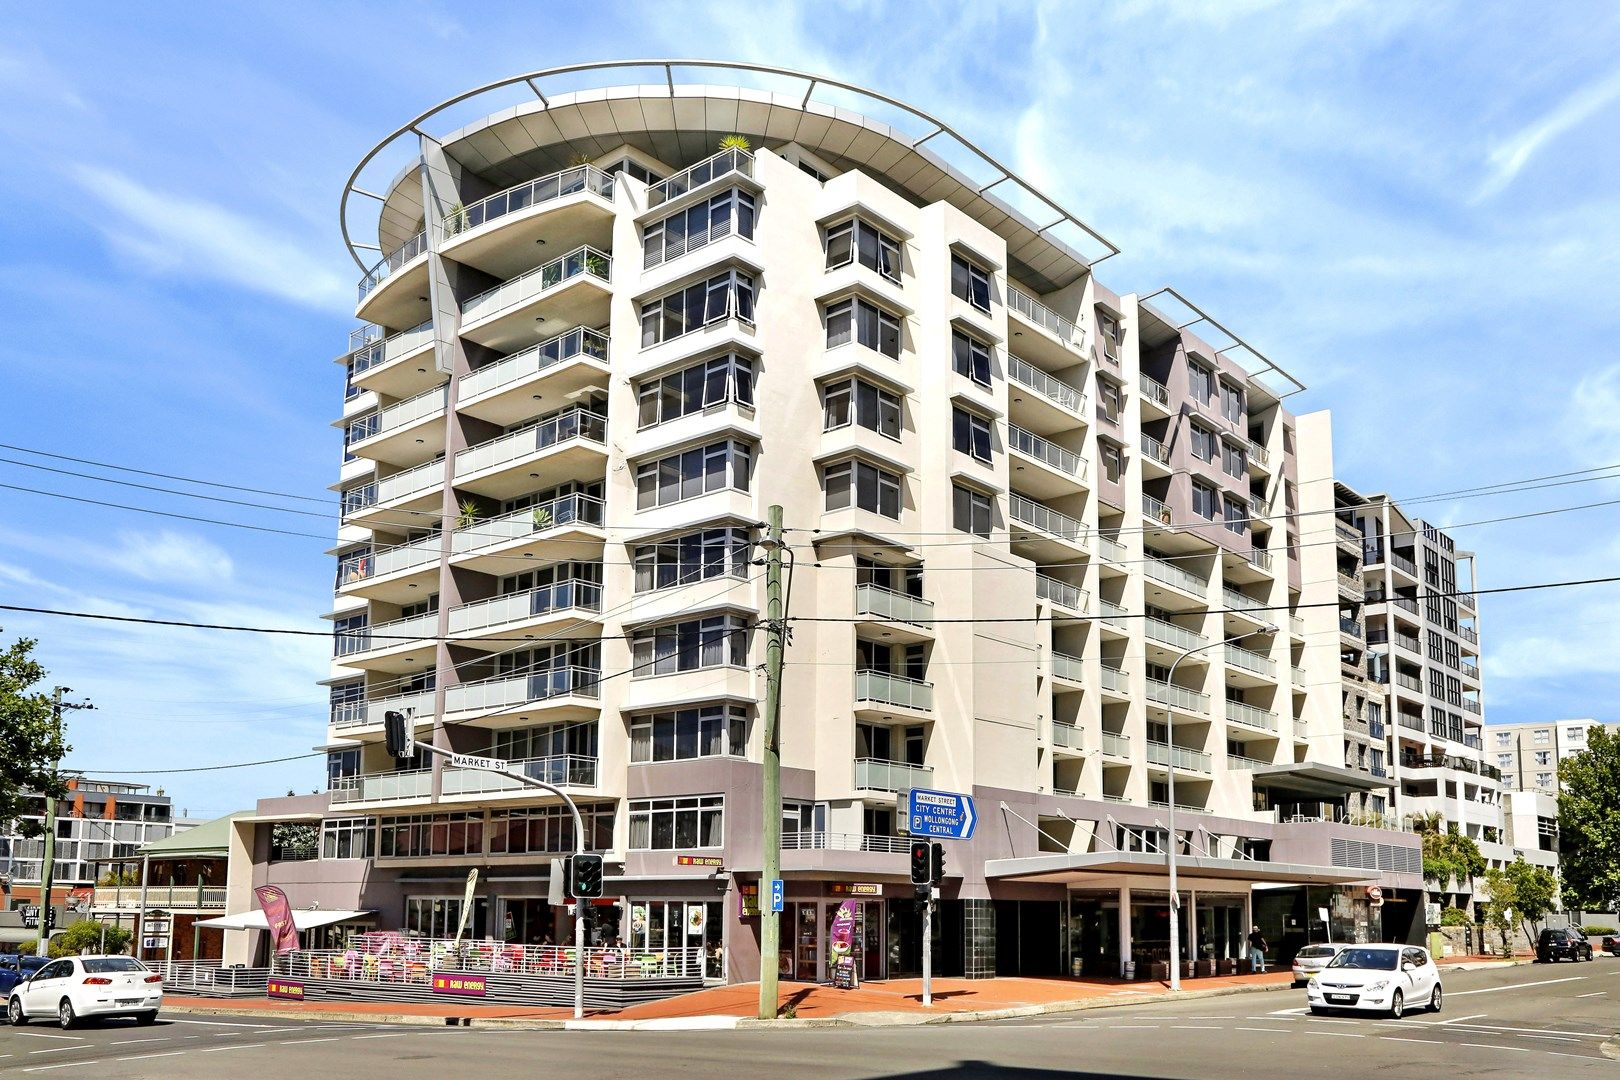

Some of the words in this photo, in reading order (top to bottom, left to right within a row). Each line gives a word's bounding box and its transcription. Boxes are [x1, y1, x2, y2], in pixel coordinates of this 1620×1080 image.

[453, 756, 490, 767] MARKET
[495, 761, 505, 770] ST
[917, 795, 936, 803] MARKET
[938, 797, 955, 805] STREET
[916, 805, 930, 813] CITY
[932, 806, 956, 817] CENTRE
[924, 815, 958, 825] WOLLONGONG
[929, 825, 953, 834] CENTRAL
[773, 892, 782, 908] P
